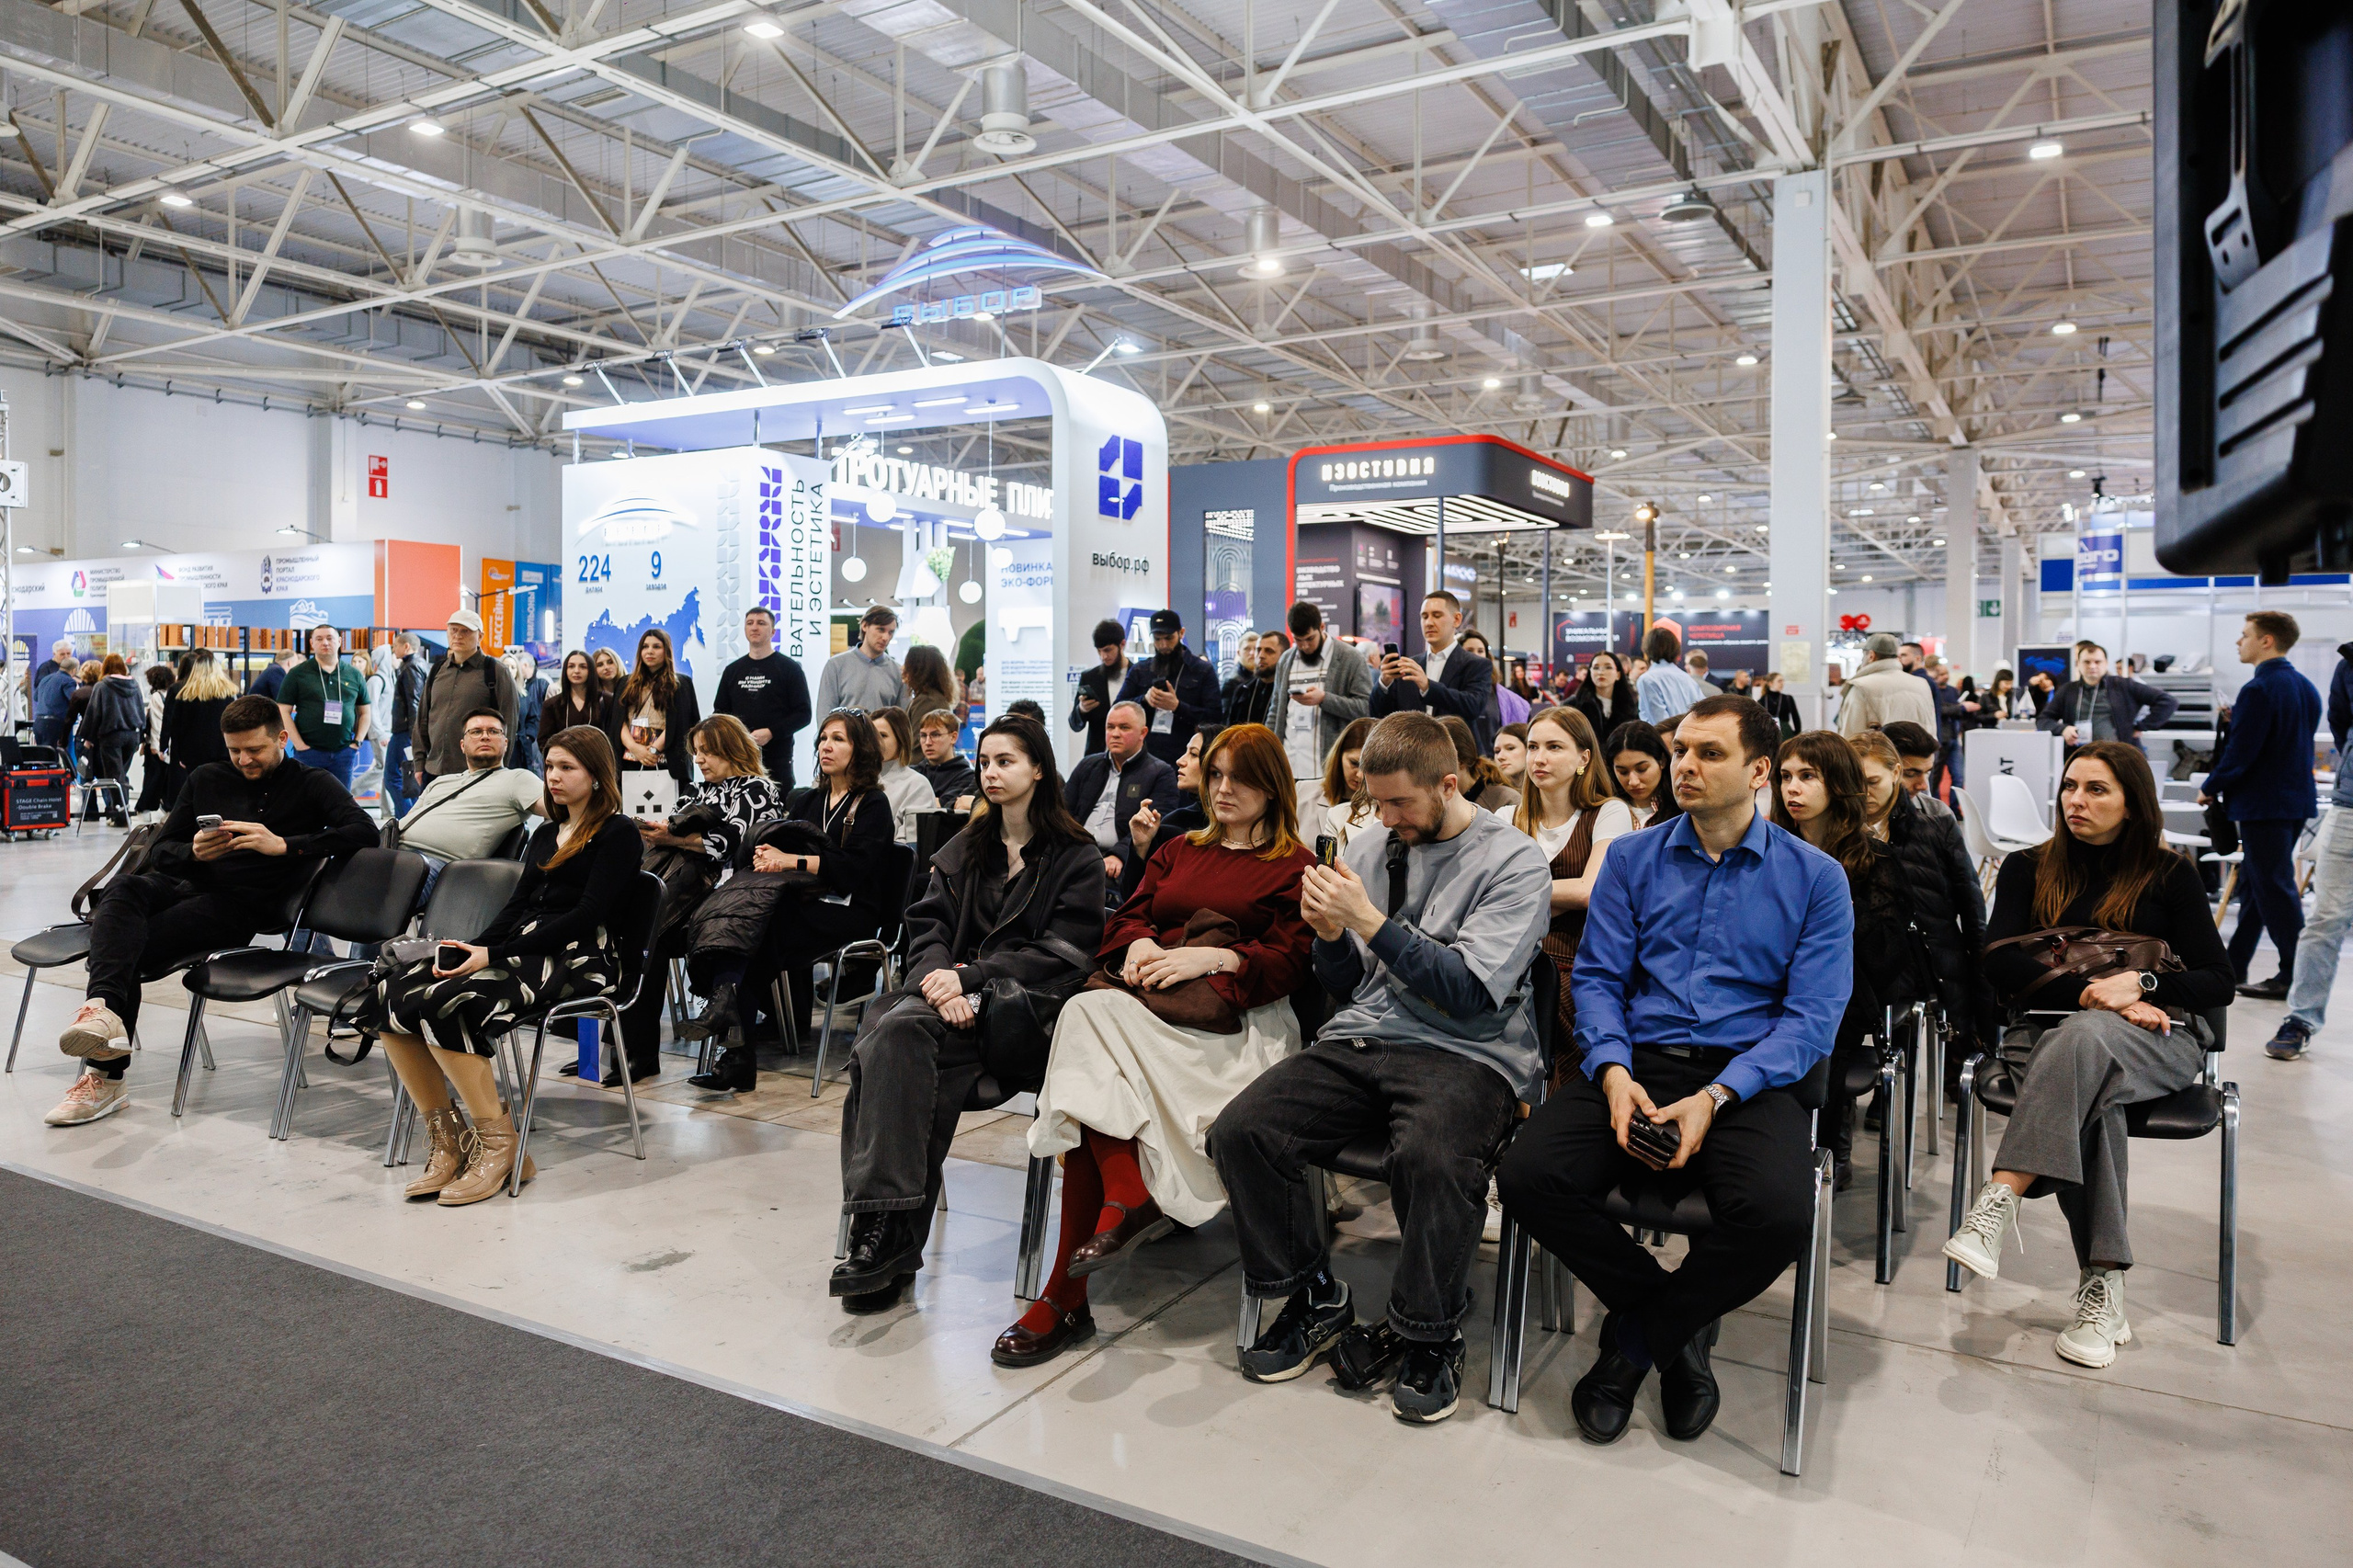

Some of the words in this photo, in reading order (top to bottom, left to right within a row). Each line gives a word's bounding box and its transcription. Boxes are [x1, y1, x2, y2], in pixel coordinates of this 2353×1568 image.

[892, 285, 1035, 324] ВЫБОР
[831, 447, 998, 509] ТРОТУАРНЫЕ
[1322, 457, 1435, 481] ИЗОСТУДИЯ
[810, 483, 824, 612] ЭСТЕТИКА
[579, 553, 611, 583] 224
[651, 551, 662, 579] 9
[790, 479, 804, 657] ВАТЕЛЬНОСТЬ
[1092, 551, 1150, 575] выбор.рф
[12, 583, 45, 595] снодарский
[1001, 576, 1053, 588] ЭКО-ФОР
[494, 588, 505, 649] БАССЕЙНЫ
[527, 591, 536, 642] АВИЛЬОНЫ
[810, 620, 822, 635] И
[1565, 634, 1620, 642] ВОЗМОЖНОИ
[1999, 757, 2014, 776] АТ
